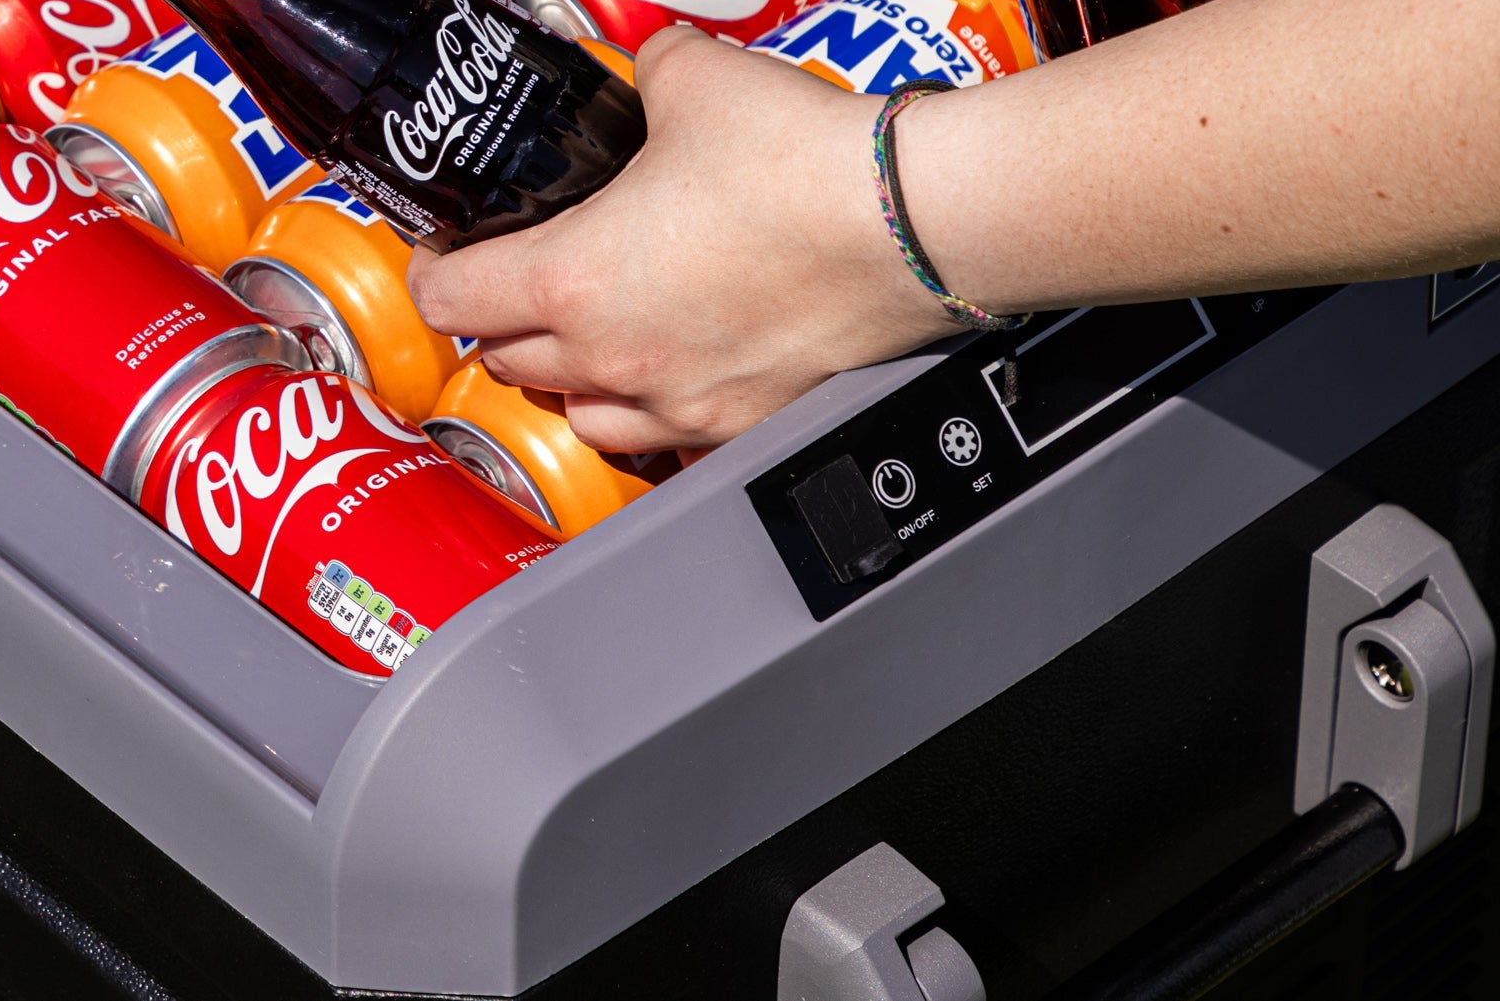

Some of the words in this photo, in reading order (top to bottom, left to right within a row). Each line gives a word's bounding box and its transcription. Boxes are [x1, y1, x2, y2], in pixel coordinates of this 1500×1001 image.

[904, 16, 975, 81] zero
[959, 25, 1006, 79] range
[454, 103, 503, 168] ORIGINAL
[496, 58, 525, 99] TASTE
[473, 127, 506, 176] Delicious
[502, 121, 512, 131] &
[508, 73, 540, 124] Refreshing
[335, 160, 363, 184] ME
[375, 184, 392, 198] SEE
[378, 180, 397, 195] THIS
[362, 183, 437, 234] RECYCLE
[1251, 298, 1265, 313] UP
[115, 310, 182, 364] Delicious
[182, 301, 196, 312] &
[127, 311, 207, 371] Refreshing
[321, 453, 451, 533] ORIGINAL
[972, 472, 993, 492] SET
[898, 509, 935, 540] ON/OFF
[306, 572, 320, 592] 330ml
[311, 581, 328, 603] Energy
[318, 586, 333, 607] 594kJ
[323, 591, 341, 614] 139kcal
[337, 605, 347, 618] Fat
[344, 612, 355, 622] 0g
[354, 614, 372, 642] Saturates
[365, 628, 376, 639] 0g
[376, 633, 392, 656] Sugars
[385, 642, 398, 657] 35g
